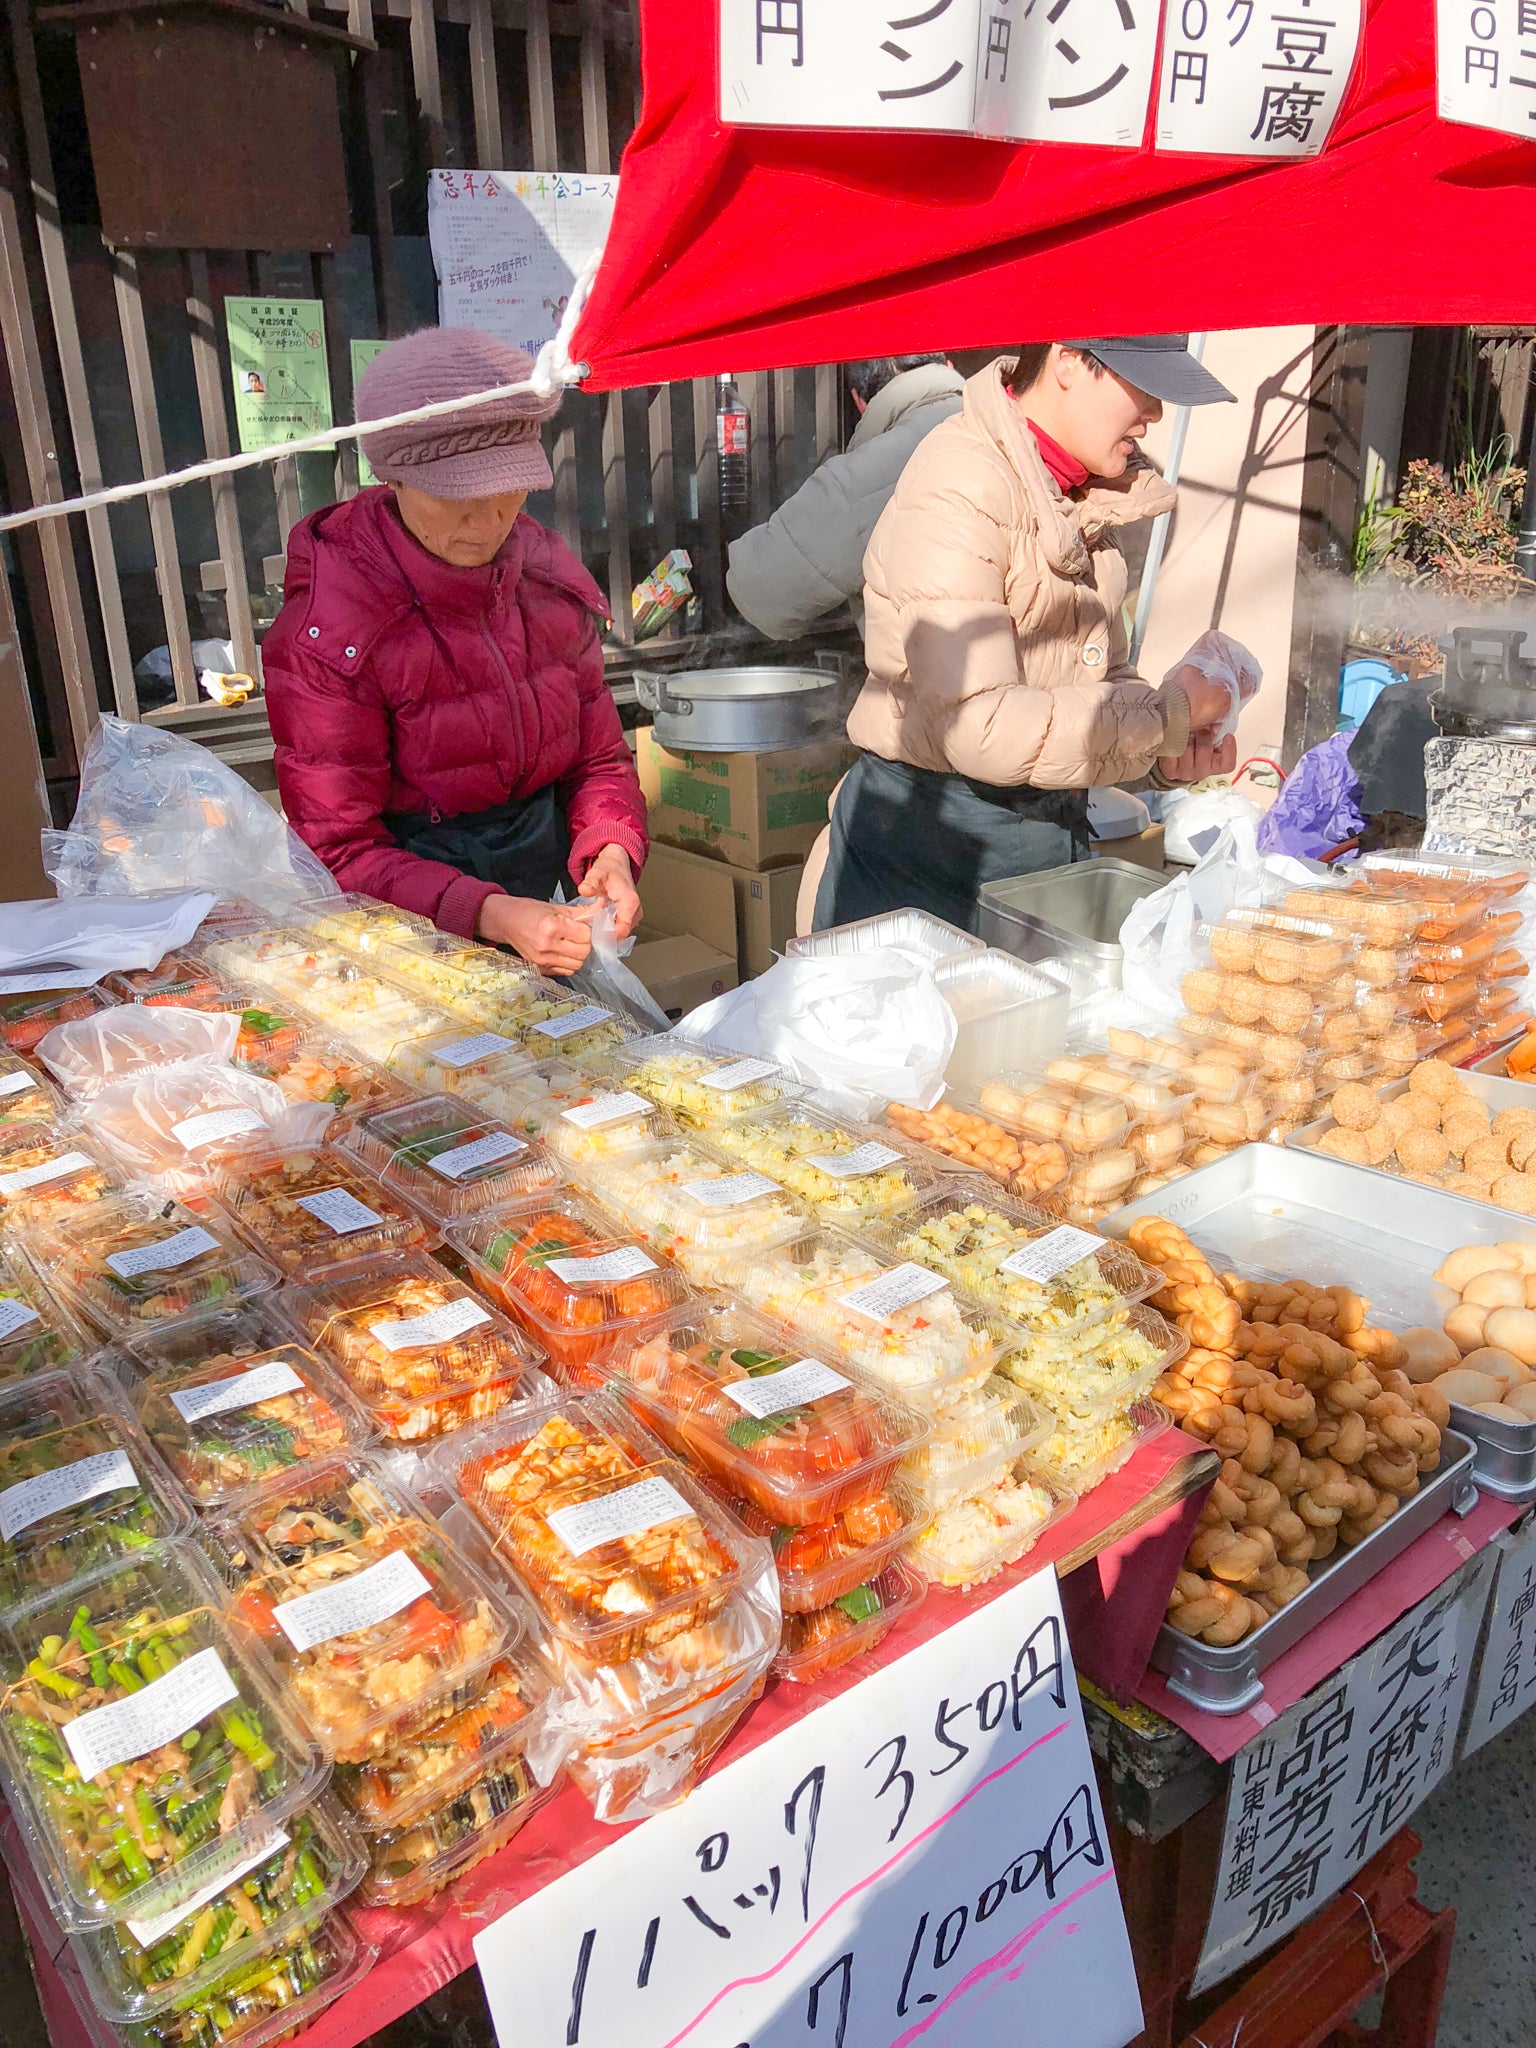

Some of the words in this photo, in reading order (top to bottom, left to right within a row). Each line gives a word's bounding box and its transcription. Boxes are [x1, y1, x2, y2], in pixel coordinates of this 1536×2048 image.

[1250, 0, 1336, 143] 豆腐
[1464, 0, 1500, 89] 0円
[443, 171, 500, 200] 忘年会
[865, 1615, 1067, 1843] 350円
[1345, 1627, 1445, 1861] 大麻花
[1224, 1740, 1276, 1902] 山東料理
[1243, 1684, 1355, 1947] 品芳斎
